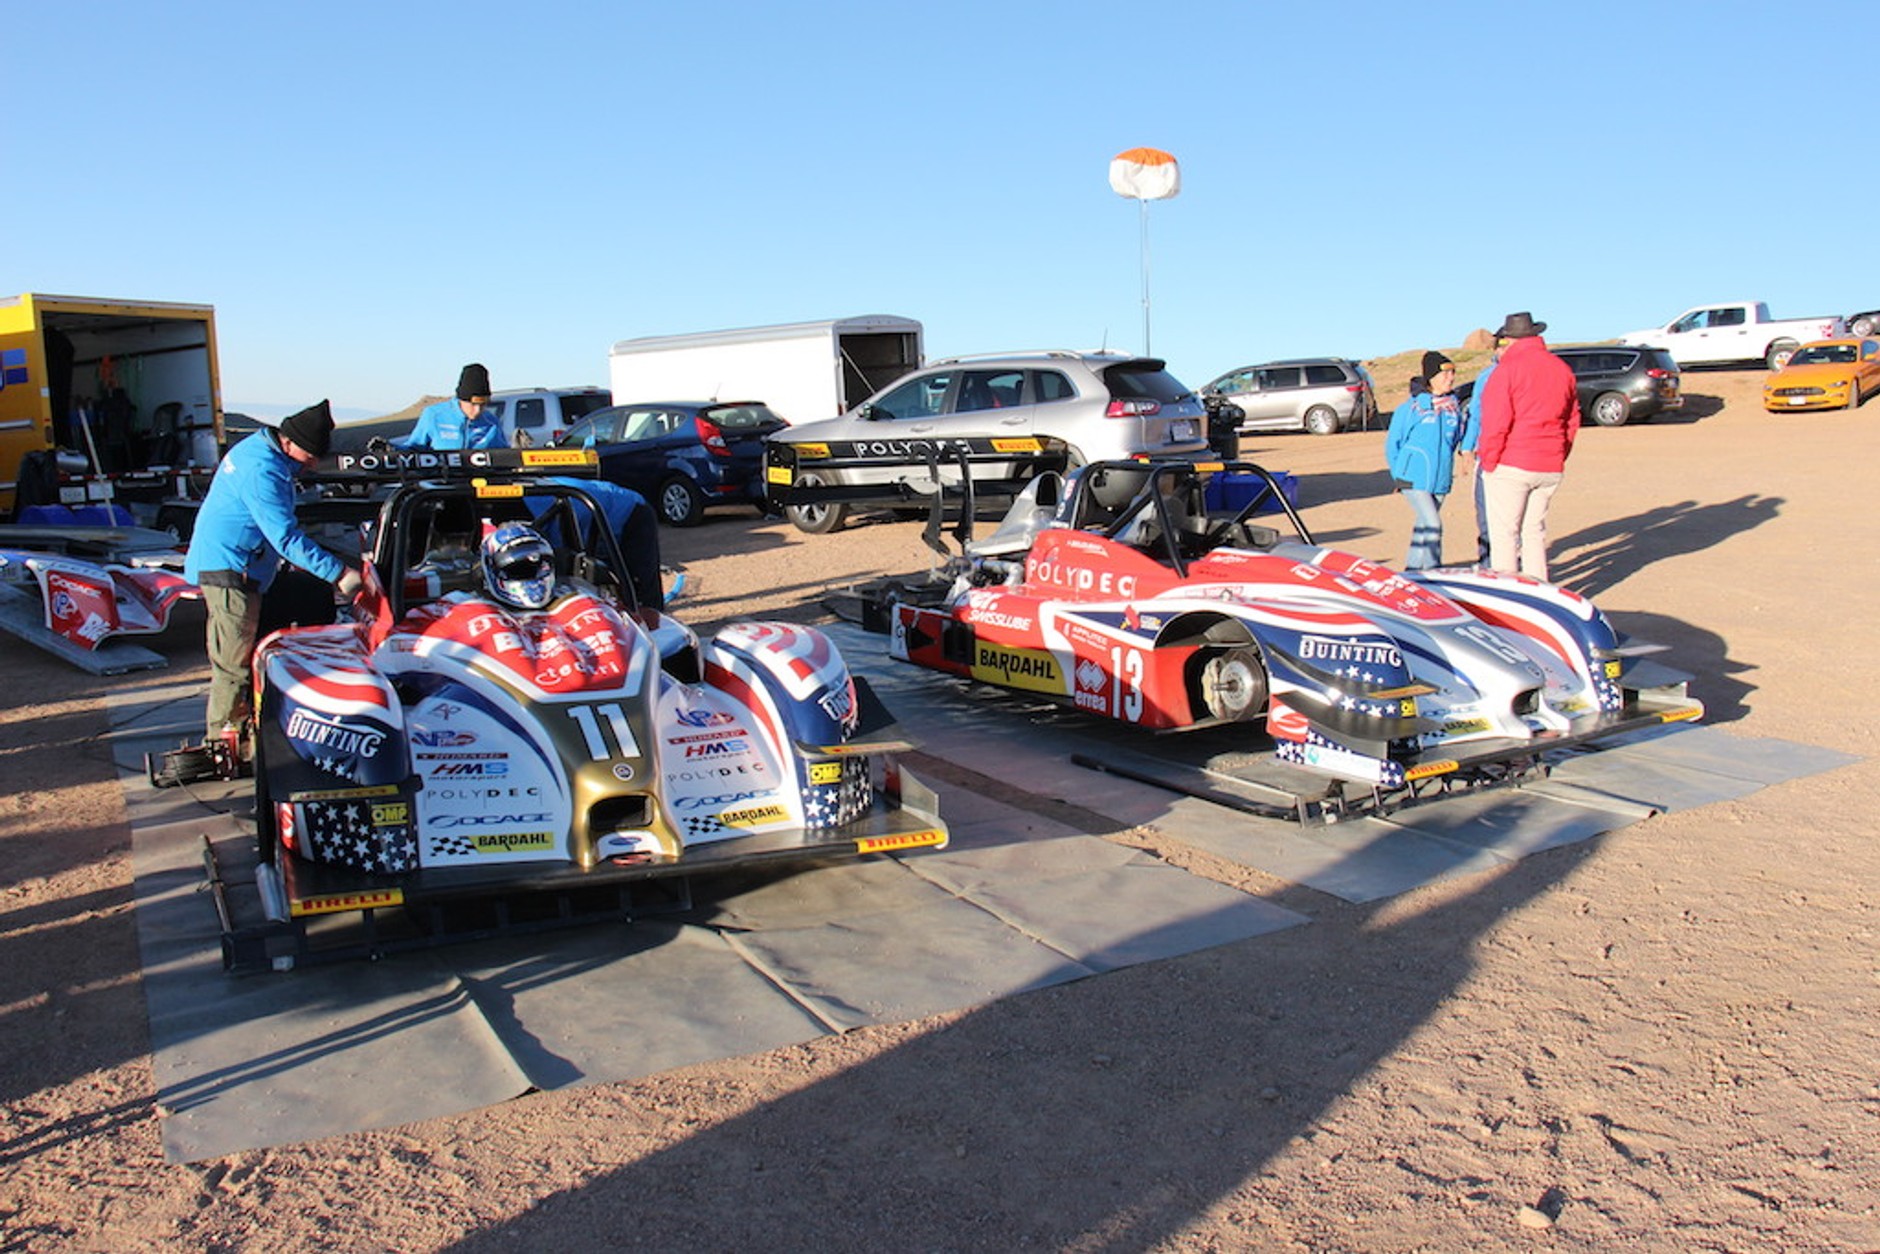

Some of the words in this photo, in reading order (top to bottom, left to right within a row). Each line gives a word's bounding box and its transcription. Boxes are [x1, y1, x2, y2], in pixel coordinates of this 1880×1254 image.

[341, 452, 487, 470] POLYDEC
[1028, 557, 1135, 597] POLYDEC
[967, 609, 1033, 632] SWISSLUBE
[1299, 635, 1402, 668] QUINTING
[979, 648, 1056, 681] BARDAHL
[1111, 645, 1144, 723] 13
[1074, 690, 1107, 713] errea
[287, 711, 383, 758] QUINTING
[566, 703, 642, 762] 11
[685, 739, 749, 757] HMS
[431, 762, 509, 775] HMS
[667, 762, 764, 782] POLYDEC
[427, 787, 538, 799] POLYDEC
[372, 808, 408, 821] OMP
[722, 806, 785, 825] BARDAHL
[478, 834, 549, 851] BARDAHL
[866, 831, 936, 848] PIRELLI
[302, 893, 391, 911] PIRELLI
